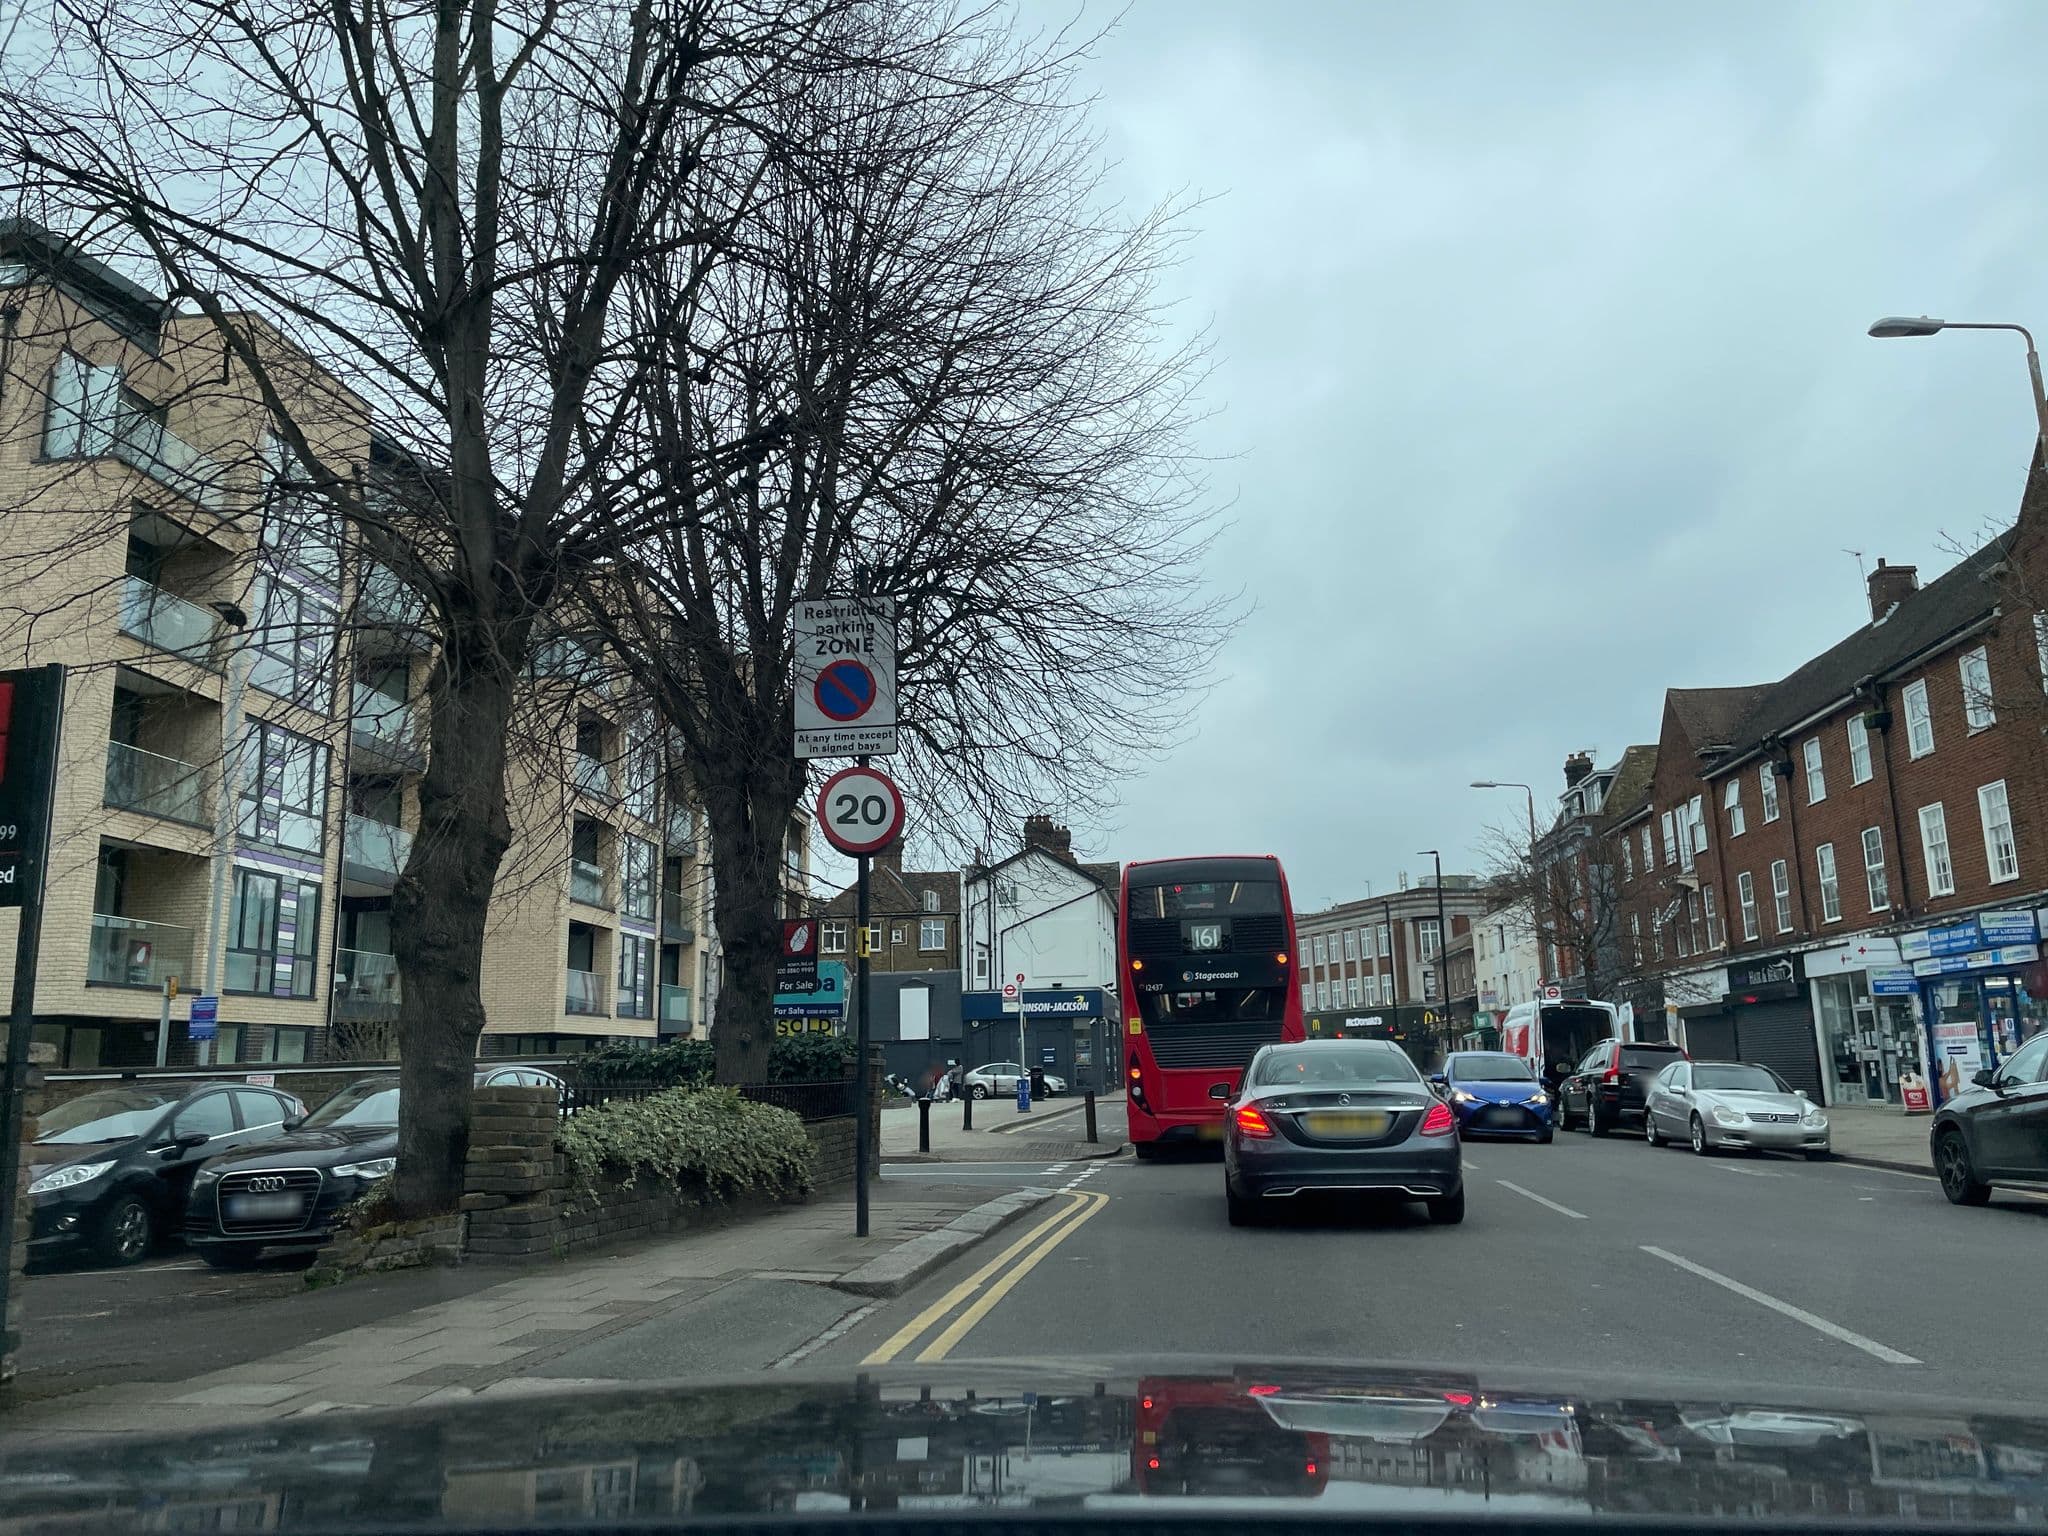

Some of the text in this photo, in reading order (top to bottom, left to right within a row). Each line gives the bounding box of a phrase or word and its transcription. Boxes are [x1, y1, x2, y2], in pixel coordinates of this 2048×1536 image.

[816, 620, 875, 637] parking
[816, 637, 874, 655] ZONE
[798, 730, 893, 743] At any time except
[809, 742, 881, 754] in signed bays
[835, 794, 887, 826] 20
[1195, 928, 1218, 947] 161
[1194, 971, 1239, 981] Stagecoach
[779, 980, 814, 991] For Sale
[1145, 983, 1163, 992] 12437
[774, 1007, 786, 1015] For
[788, 1006, 805, 1015] Sale
[777, 1019, 832, 1033] SOLD
